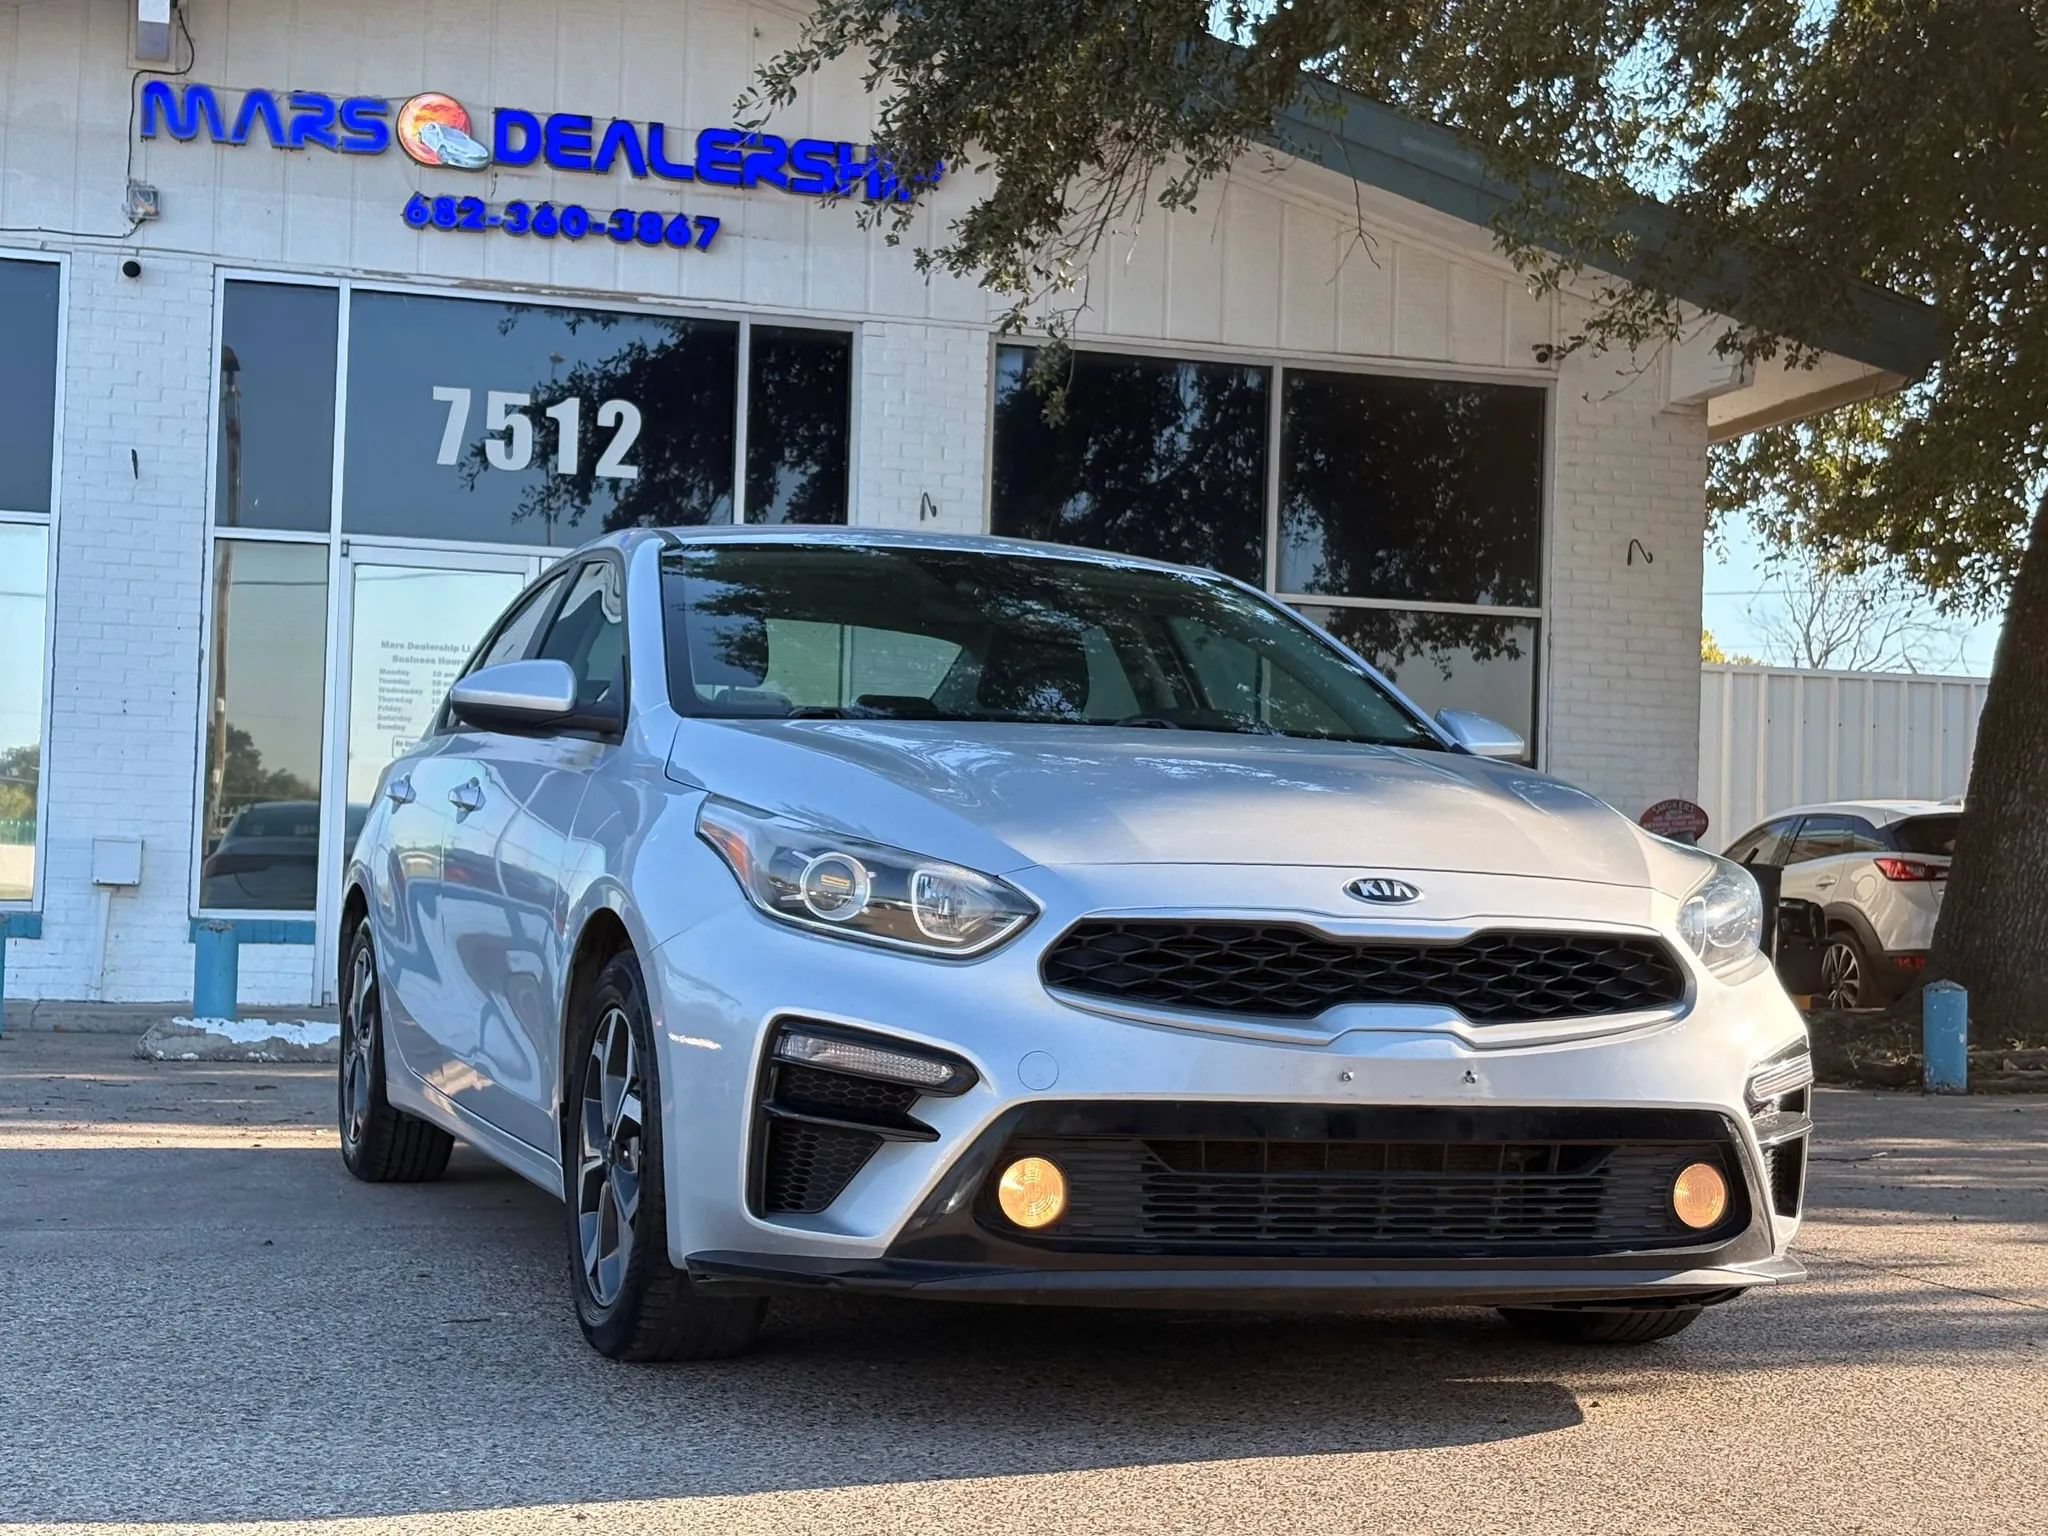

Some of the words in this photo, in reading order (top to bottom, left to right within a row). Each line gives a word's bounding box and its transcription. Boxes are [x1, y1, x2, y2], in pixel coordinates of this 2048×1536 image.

[141, 80, 390, 153] MARS
[492, 107, 944, 202] DEALERSHI
[402, 191, 720, 252] 682-360-3867
[432, 386, 642, 479] 7512
[407, 641, 460, 653] Dealership
[1356, 880, 1413, 898] KIA
